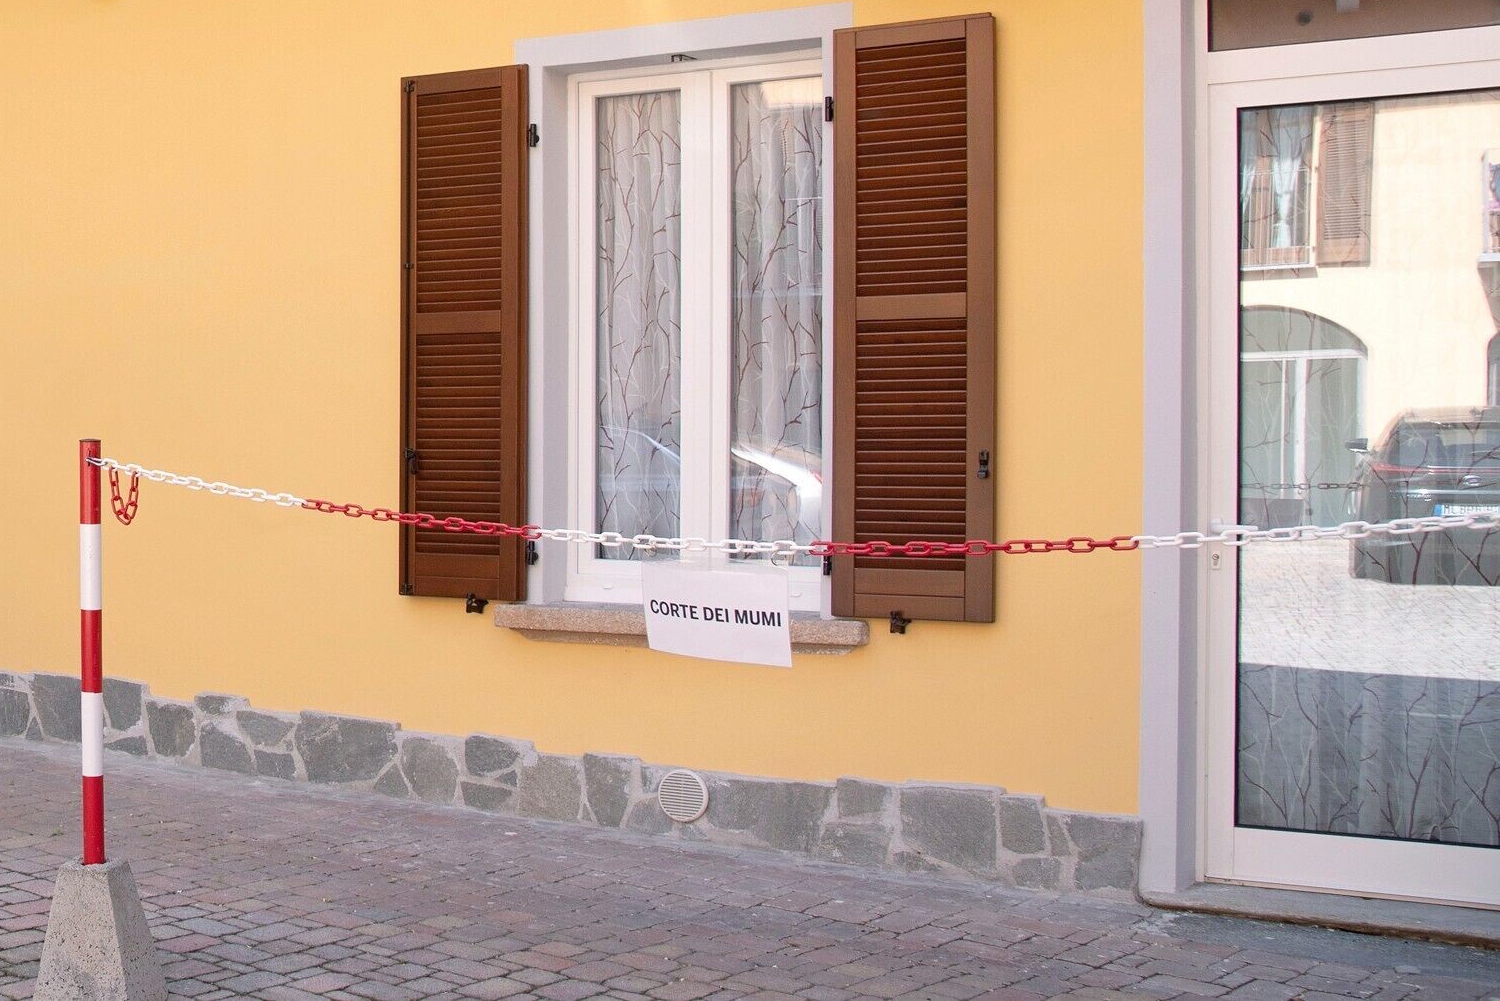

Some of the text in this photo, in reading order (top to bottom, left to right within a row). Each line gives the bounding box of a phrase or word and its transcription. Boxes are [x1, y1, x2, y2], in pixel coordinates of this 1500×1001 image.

[650, 599, 781, 627] CORTE DEI MUMI
